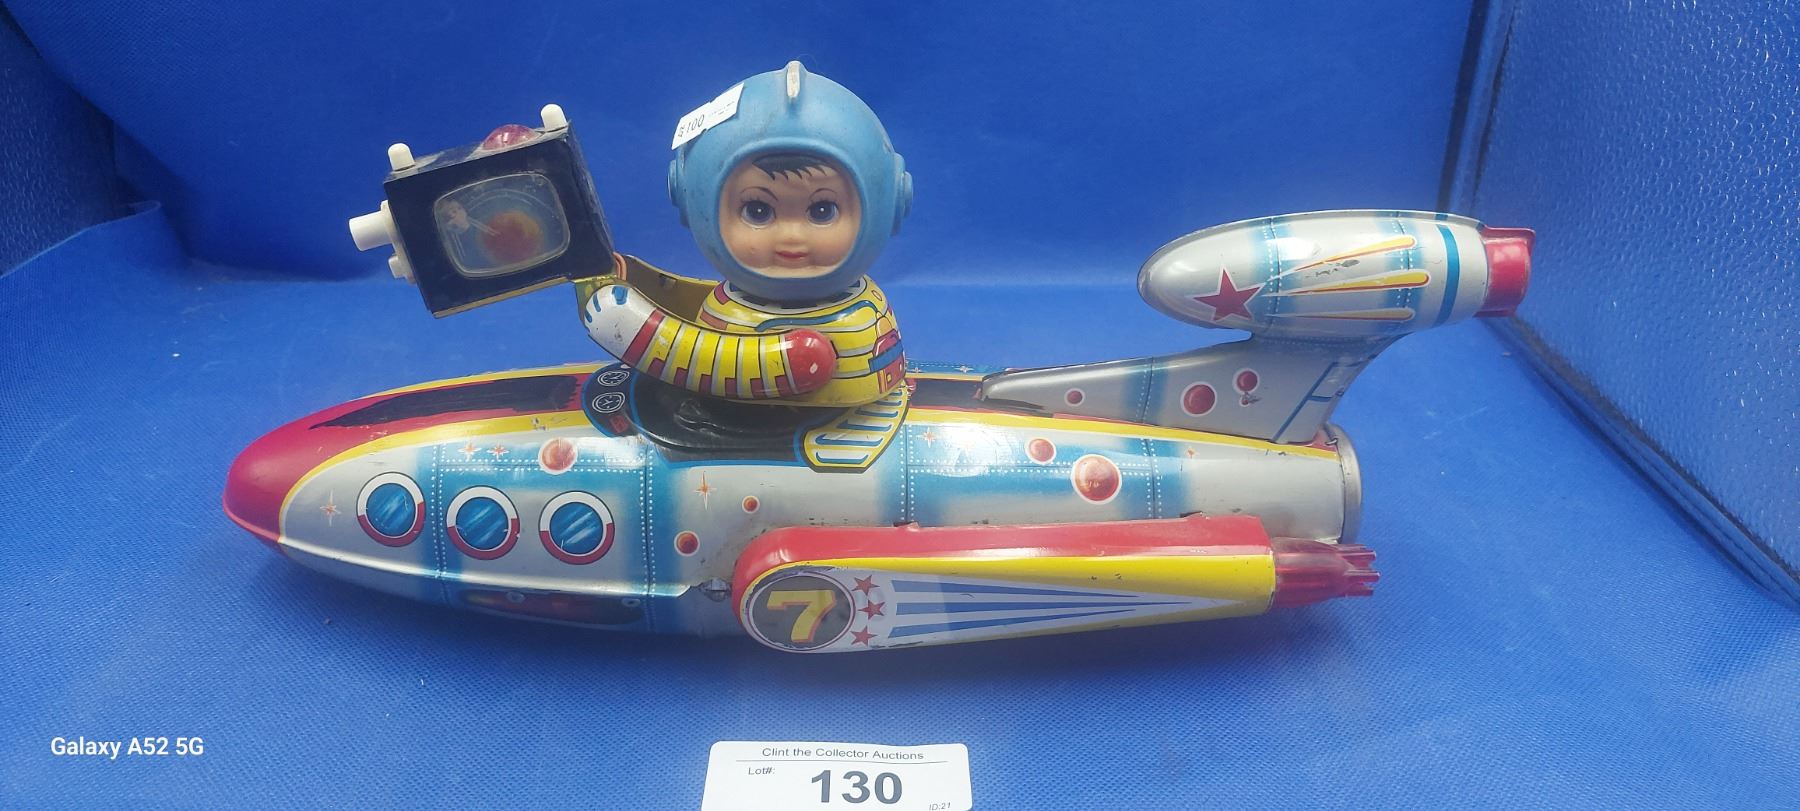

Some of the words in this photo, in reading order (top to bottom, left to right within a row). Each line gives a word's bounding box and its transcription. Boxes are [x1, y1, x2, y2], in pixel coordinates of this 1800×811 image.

[767, 590, 836, 643] 7
[762, 747, 790, 758] Clint
[793, 747, 811, 757] the
[815, 748, 870, 759] Collector
[872, 750, 924, 760] Auctions
[748, 766, 775, 775] Lot#:
[811, 769, 903, 805] 130
[929, 801, 951, 811] ID:21
